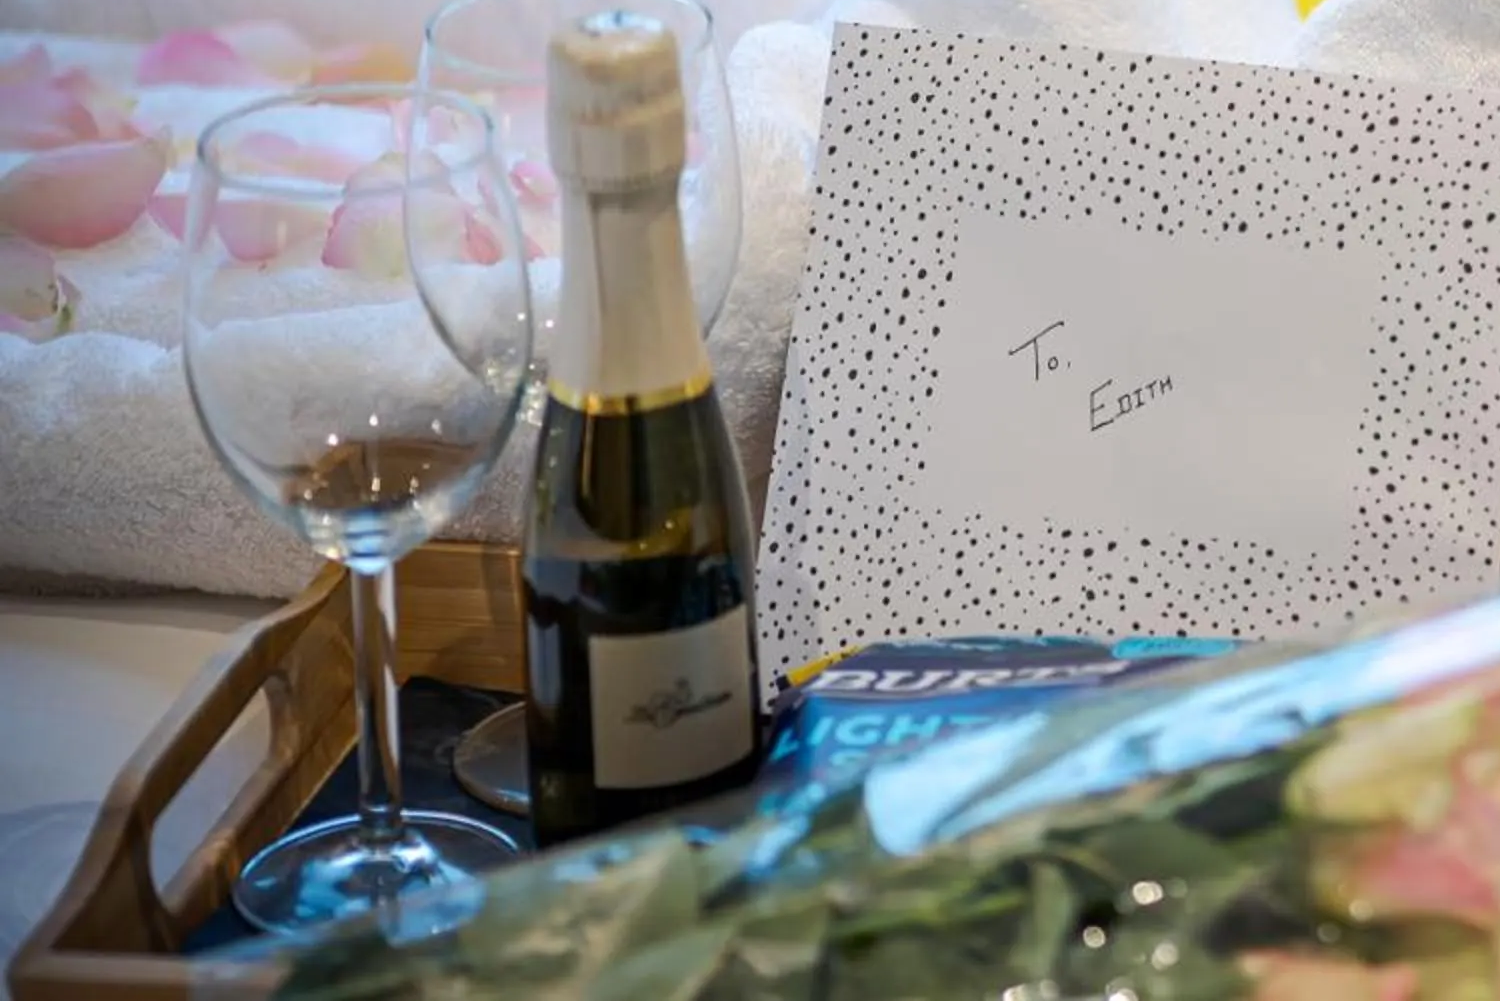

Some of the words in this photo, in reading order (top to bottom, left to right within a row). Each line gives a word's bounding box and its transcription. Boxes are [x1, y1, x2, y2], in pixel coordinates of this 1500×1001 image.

[1008, 321, 1072, 381] To,
[1089, 375, 1173, 431] EDITH
[770, 713, 988, 762] LIGH
